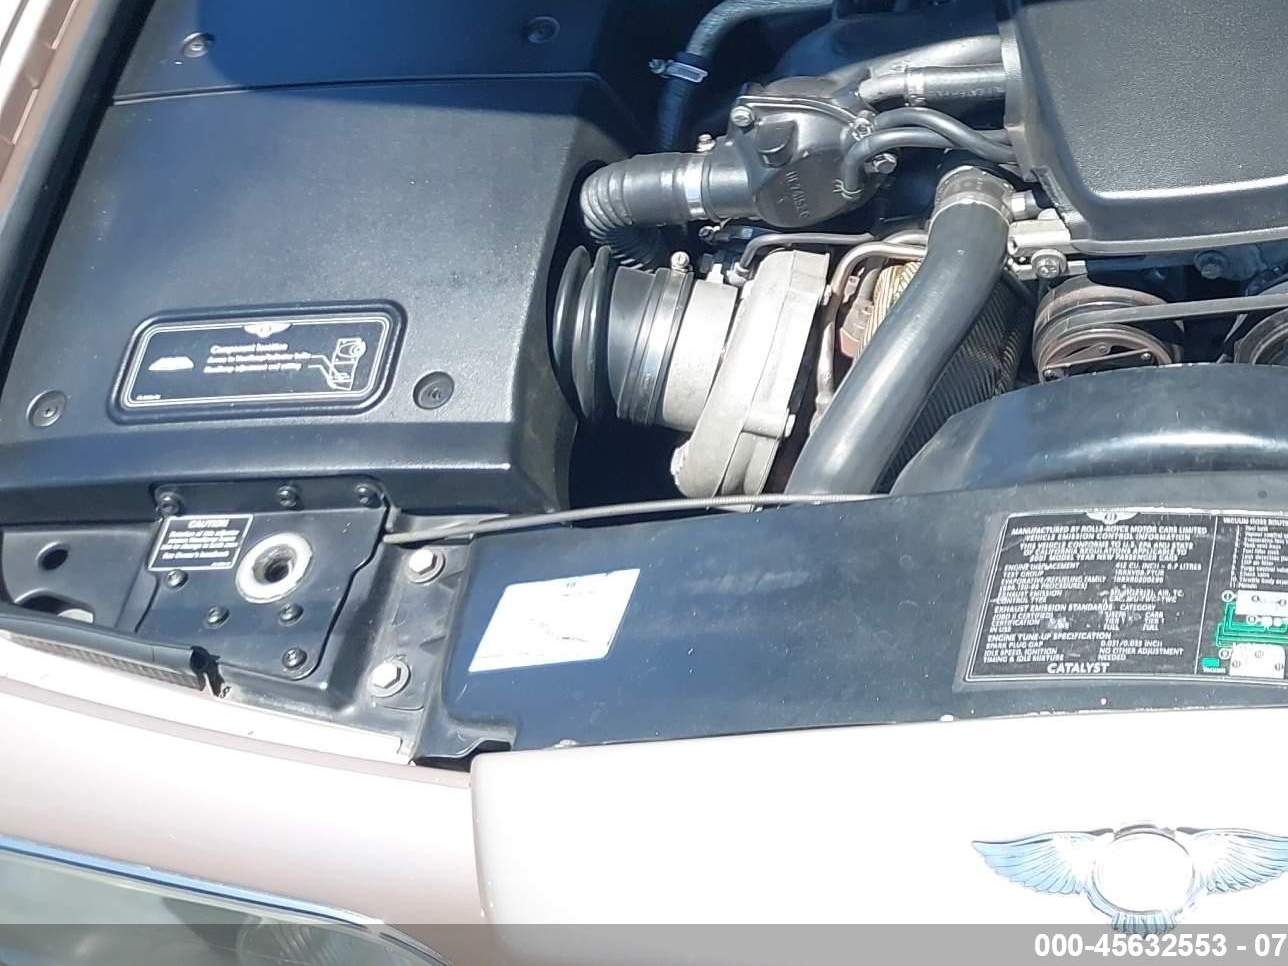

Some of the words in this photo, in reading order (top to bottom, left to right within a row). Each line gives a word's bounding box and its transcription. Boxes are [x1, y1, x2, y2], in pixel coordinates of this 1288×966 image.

[188, 520, 230, 528] CAUTION
[1223, 517, 1249, 525] VACUUM
[1011, 526, 1069, 536] MANUFACTURED
[1070, 526, 1080, 534] BY
[1082, 525, 1129, 534] ROLLS-ROYCE
[1130, 526, 1157, 534] MOTOR
[1159, 526, 1178, 534] CARS
[1025, 534, 1056, 542] VEHICLE
[1057, 533, 1095, 541] EMISSION
[1136, 533, 1191, 541] INFORMATION
[1020, 542, 1036, 550] THIS
[1171, 541, 1194, 550] STATE
[1034, 548, 1077, 556] CALIFORNIA
[1078, 547, 1132, 555] REGULATIONS
[1134, 547, 1177, 555] APPLICABLE
[1178, 548, 1188, 556] TO
[1029, 555, 1047, 563] 2001
[1049, 554, 1076, 562] MODEL
[1115, 553, 1158, 561] PASSENGER
[1159, 554, 1178, 562] CARS
[1030, 562, 1081, 570] DISPLACEMENT
[1180, 563, 1202, 571] LITRES
[1020, 570, 1044, 578] GROUP
[1030, 589, 1063, 597] EMISSION
[994, 605, 1030, 613] EXHAUST
[1030, 604, 1067, 612] EMISSION
[1068, 603, 1113, 612] STANDARDS
[1120, 603, 1156, 611] CATEGORY
[992, 619, 1041, 627] CERTIFICATION
[988, 634, 1017, 643] ENGINE
[1017, 633, 1052, 641] TUNE-UP
[1053, 632, 1112, 640] SPECIFICATION
[986, 642, 1007, 650] SPARK
[1008, 641, 1027, 649] PLUG
[1028, 640, 1044, 648] GAP
[1024, 647, 1058, 655] IGNITION
[1138, 648, 1185, 656] ADJUSTMENT
[983, 656, 1008, 664] TIMING
[1032, 654, 1064, 662] MIXTURE
[1047, 662, 1110, 674] CATALYST
